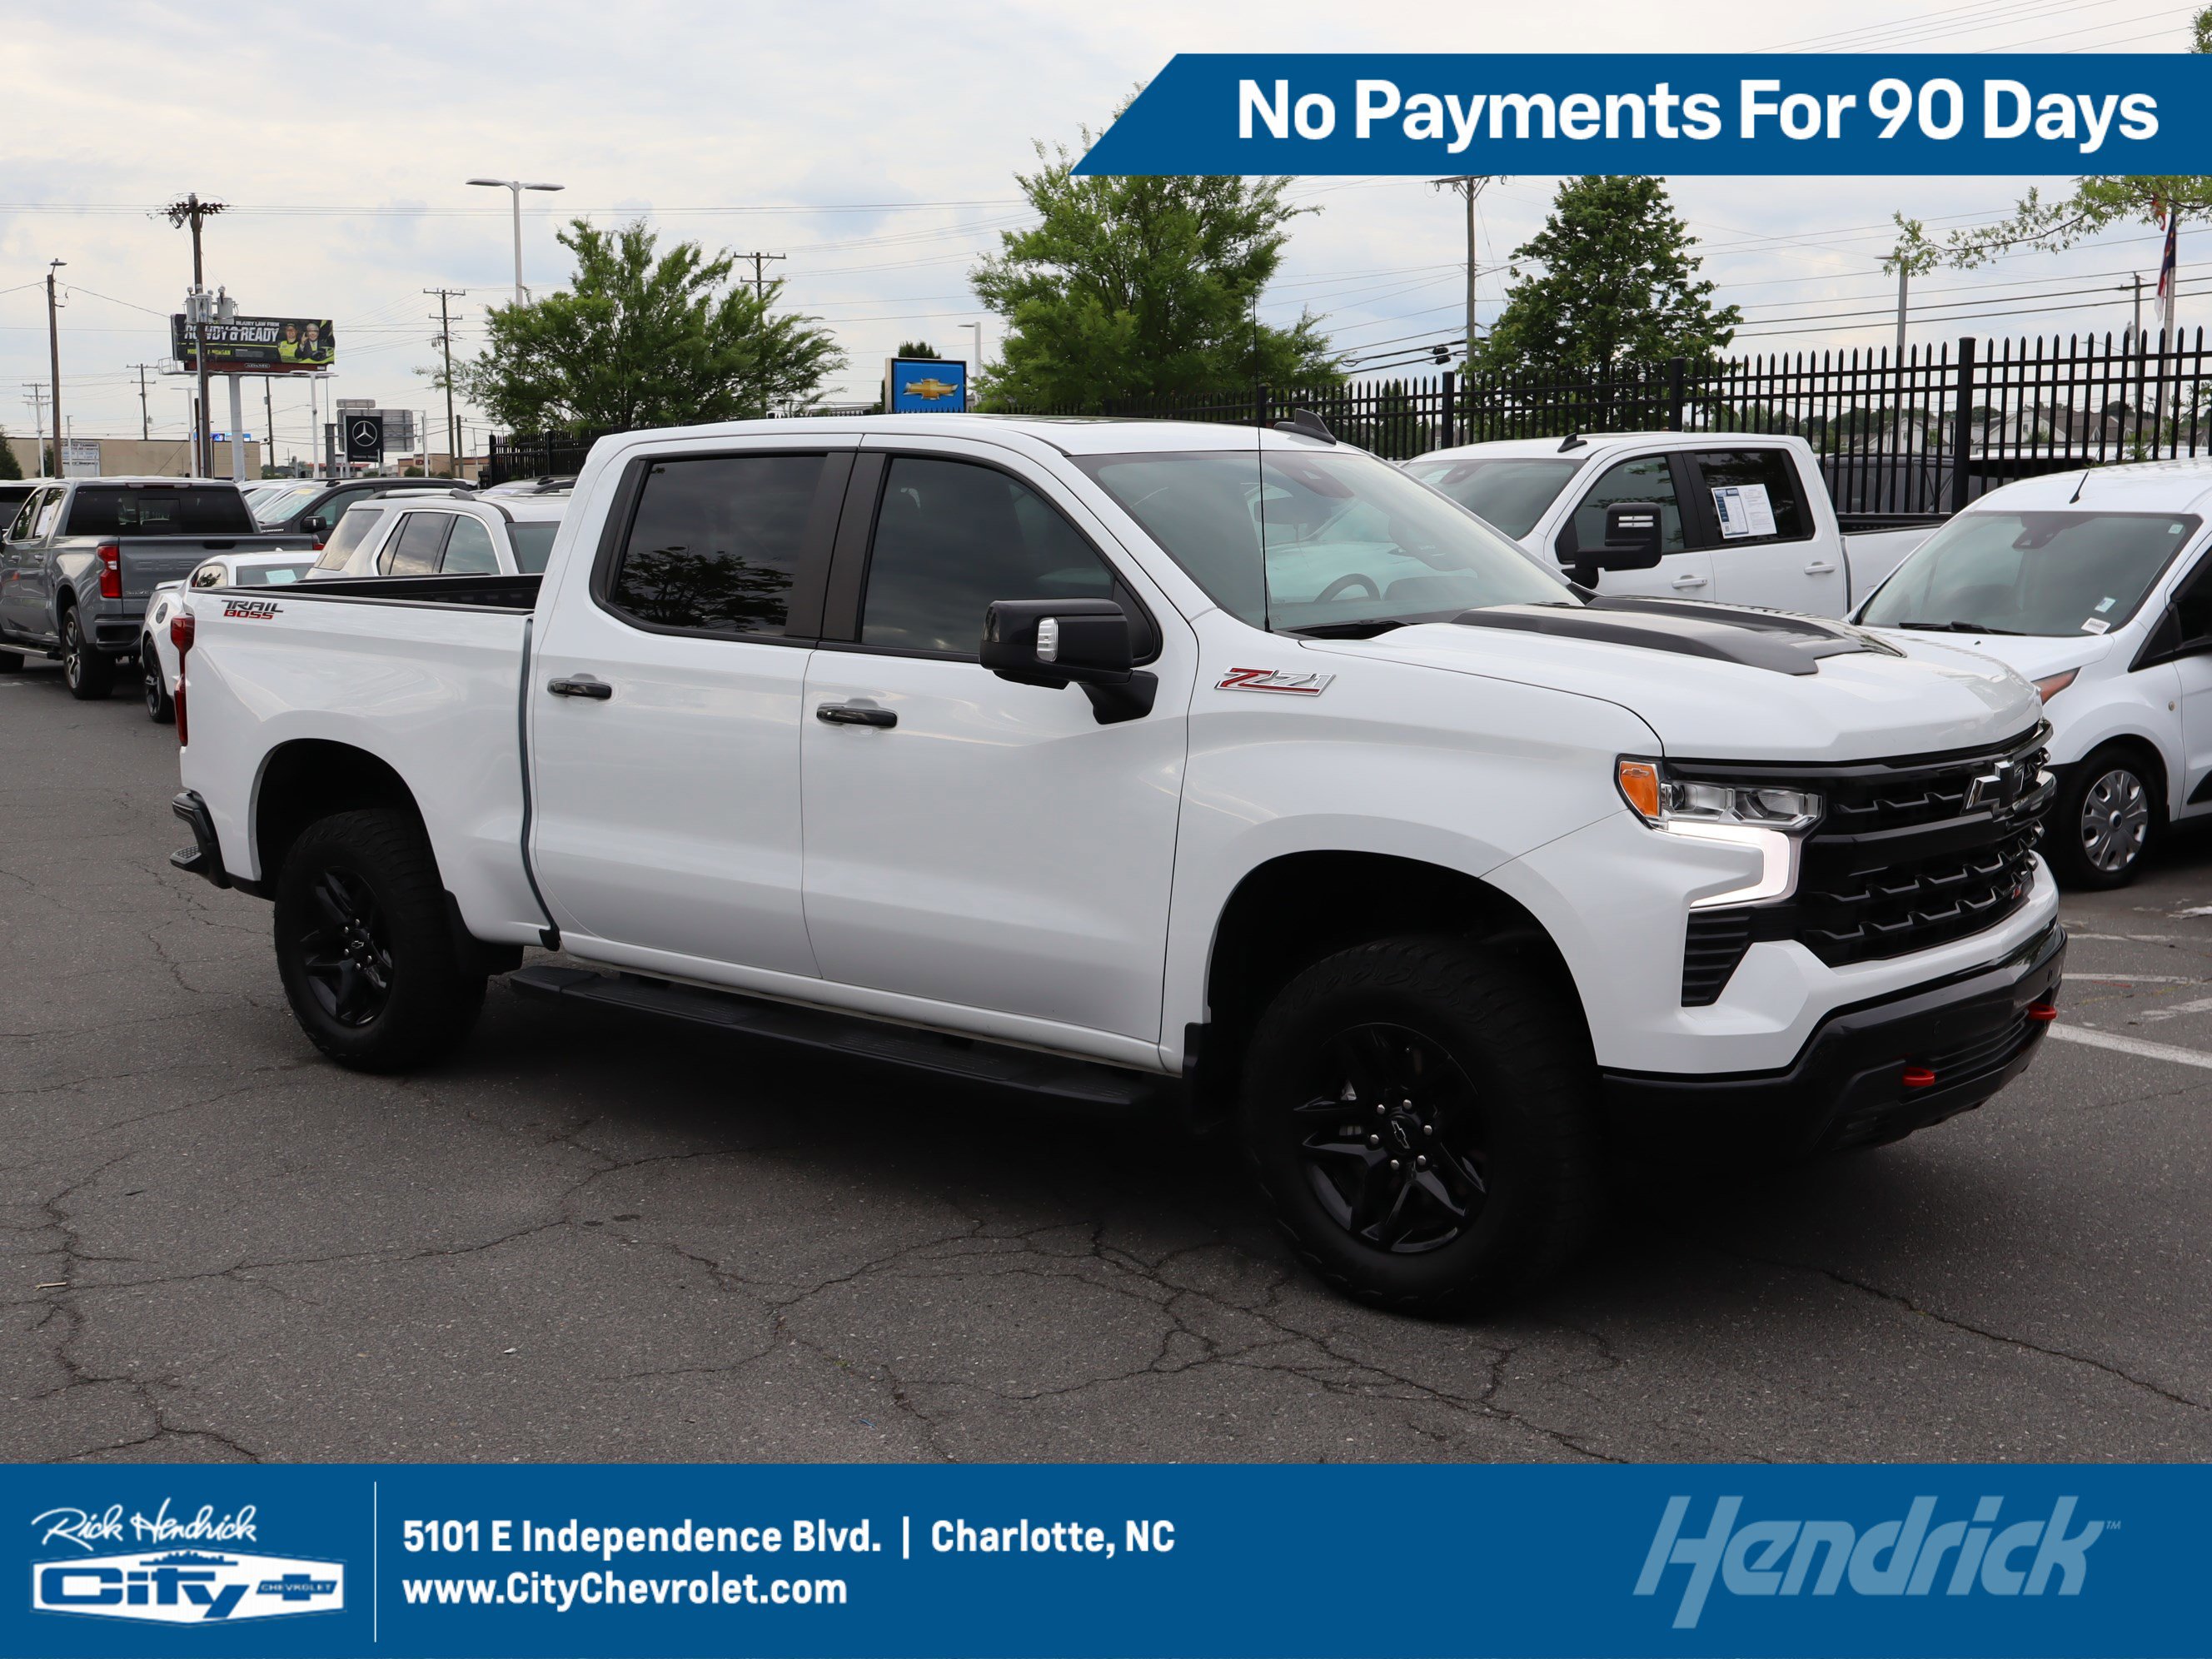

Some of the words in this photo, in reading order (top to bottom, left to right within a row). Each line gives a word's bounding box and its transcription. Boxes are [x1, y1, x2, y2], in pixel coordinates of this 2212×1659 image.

[240, 326, 280, 342] READY
[222, 599, 284, 613] TRAIL
[223, 609, 275, 620] BOSS
[1213, 665, 1337, 697] Z71
